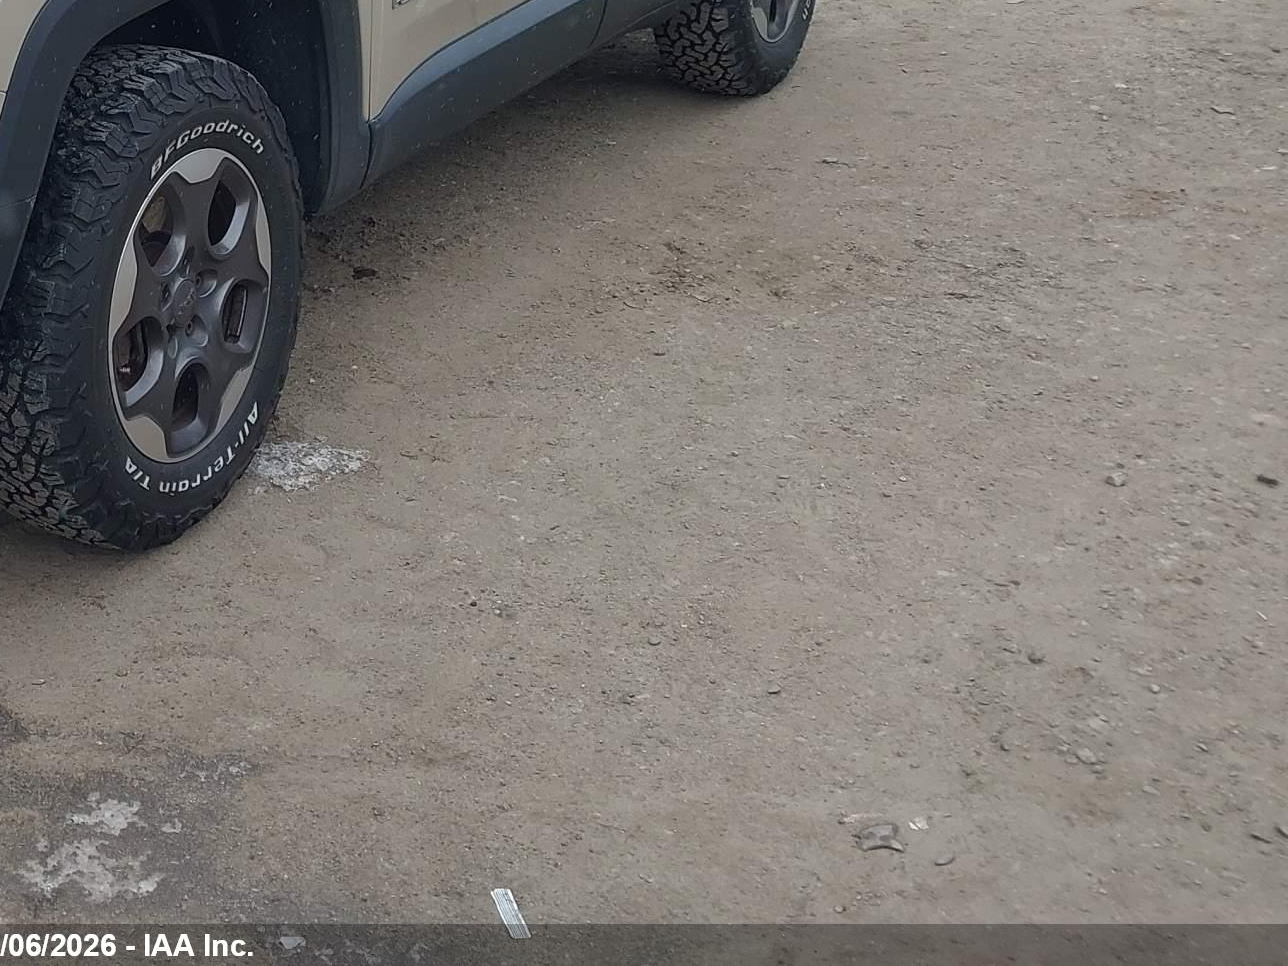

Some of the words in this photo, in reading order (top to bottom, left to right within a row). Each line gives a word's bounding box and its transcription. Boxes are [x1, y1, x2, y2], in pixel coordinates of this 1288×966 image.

[150, 119, 265, 180] BFGoodrich
[124, 455, 152, 491] T/A
[158, 400, 259, 497] All-Terrain
